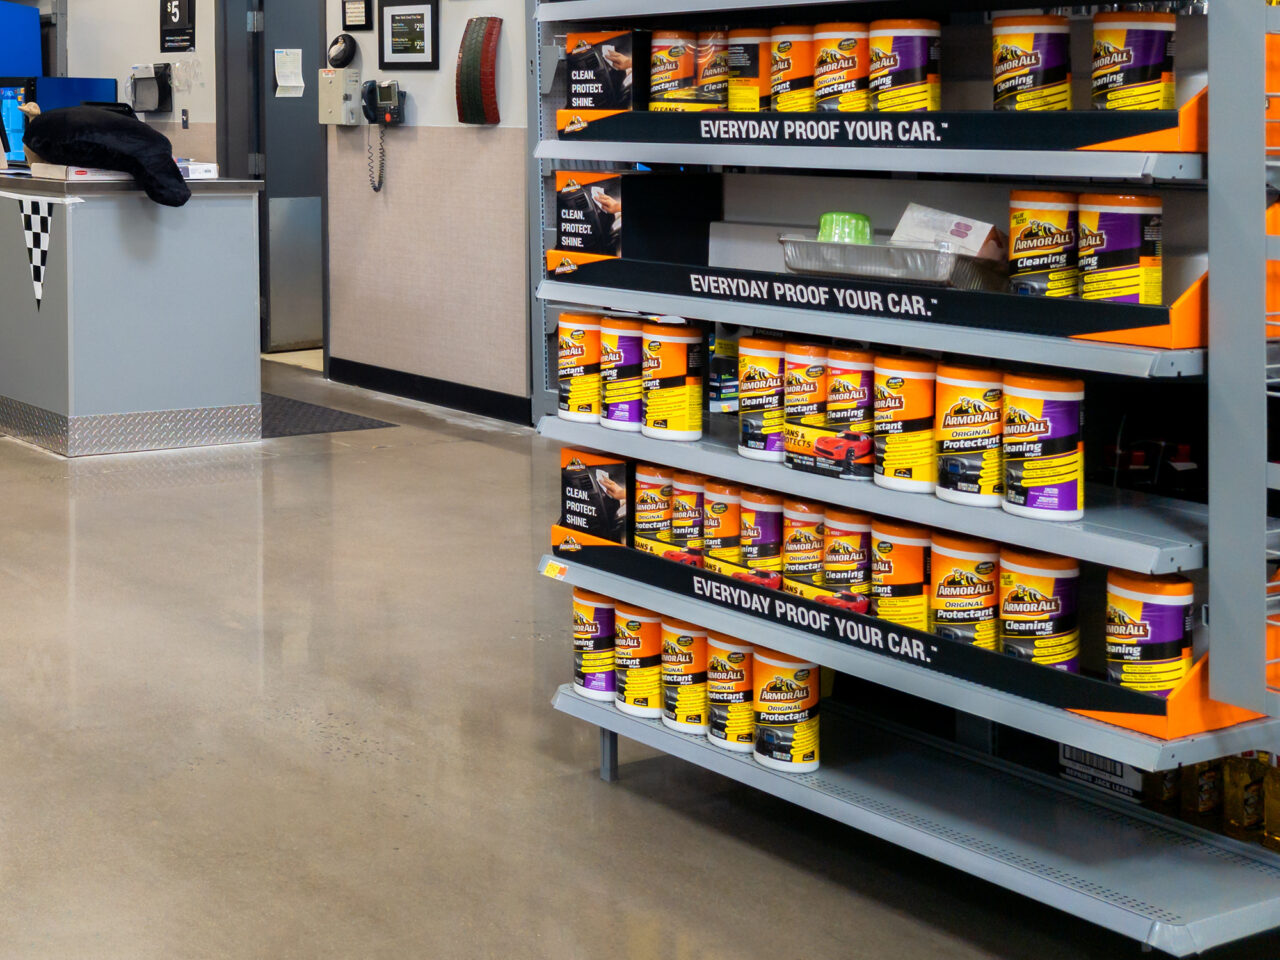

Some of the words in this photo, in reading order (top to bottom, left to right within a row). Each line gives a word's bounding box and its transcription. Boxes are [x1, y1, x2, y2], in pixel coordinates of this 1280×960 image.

[167, 0, 180, 22] $5
[572, 70, 596, 81] CLEAN.
[572, 83, 603, 94] PROTECT.
[997, 74, 1034, 92] Cleaning
[572, 97, 595, 108] SHINE.
[701, 120, 779, 139] EVERYDAY
[784, 121, 839, 140] PROOF
[844, 121, 893, 141] YOUR
[561, 209, 585, 220] CLEAN.
[561, 223, 593, 235] PROTECT.
[561, 236, 584, 247] SHINE.
[1018, 254, 1067, 268] Cleaning
[690, 273, 769, 300] EVERYDAY
[774, 281, 829, 305] PROOF
[833, 287, 884, 312] YOUR
[741, 394, 779, 407] Cleaning
[951, 428, 991, 438] ORIGINAL
[943, 436, 1000, 450] Protectant
[566, 487, 590, 501] CLEAN.
[566, 501, 597, 517] PROTECT.
[566, 514, 589, 529] SHINE.
[825, 570, 864, 580] Cleaning
[945, 600, 984, 608] ORIGINAL
[693, 575, 770, 615] EVERYDAY
[775, 599, 830, 632] PROOF
[834, 616, 884, 649] YOUR
[937, 608, 993, 619] Protectant
[1005, 620, 1053, 632] Cleaning
[768, 704, 801, 712] ORIGINAL
[760, 710, 809, 721] Protectant
